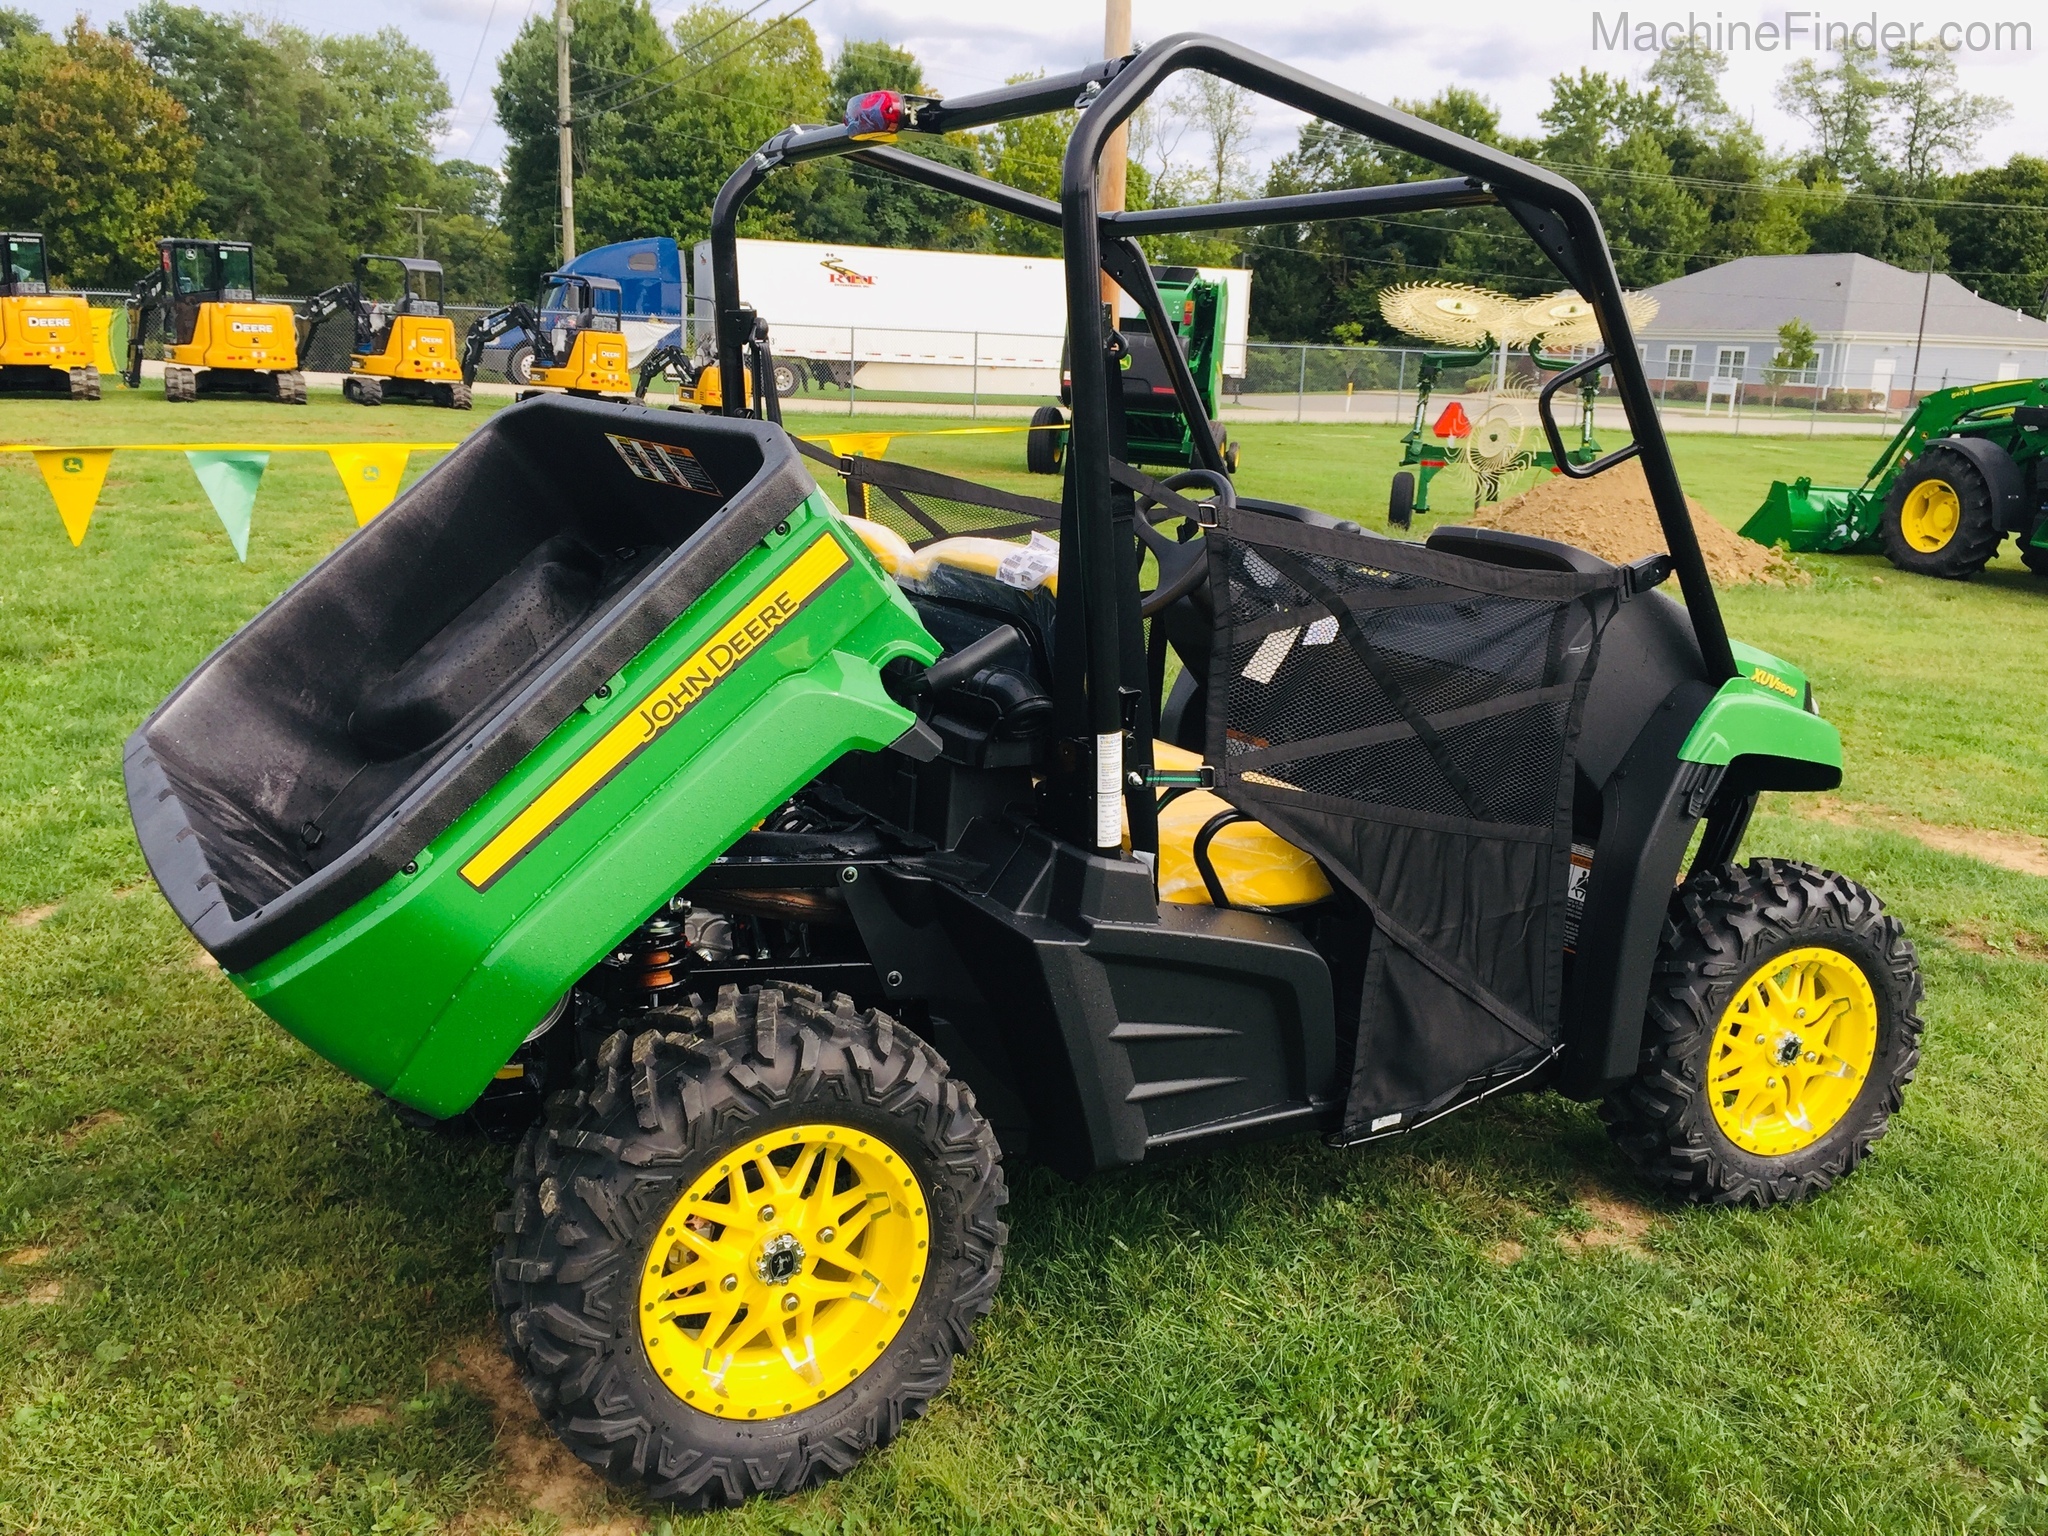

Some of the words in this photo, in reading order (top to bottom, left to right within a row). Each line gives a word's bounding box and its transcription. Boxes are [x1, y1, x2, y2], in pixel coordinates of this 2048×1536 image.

[28, 316, 71, 327] DEERE
[232, 322, 273, 333] DEERE
[640, 666, 712, 737] JOHN
[706, 591, 798, 671] DEERE
